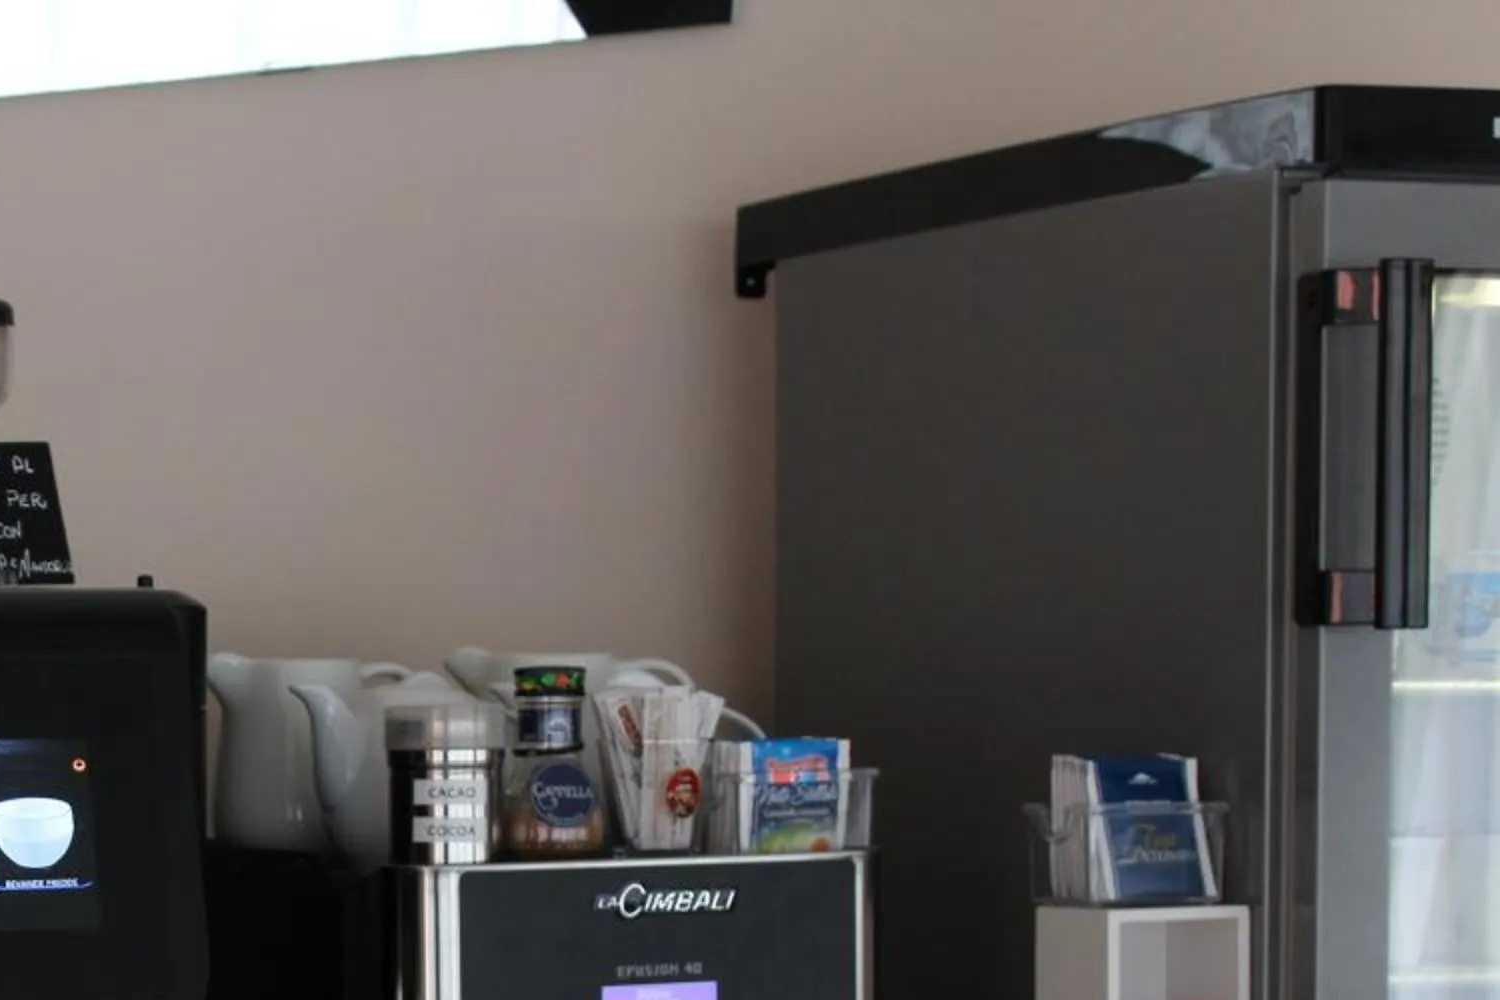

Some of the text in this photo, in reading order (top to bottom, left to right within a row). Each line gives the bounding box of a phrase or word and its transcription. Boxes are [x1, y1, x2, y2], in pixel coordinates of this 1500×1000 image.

[11, 454, 35, 474] AL
[6, 489, 48, 510] PER
[428, 786, 477, 799] CACAO
[427, 826, 476, 838] COCOA
